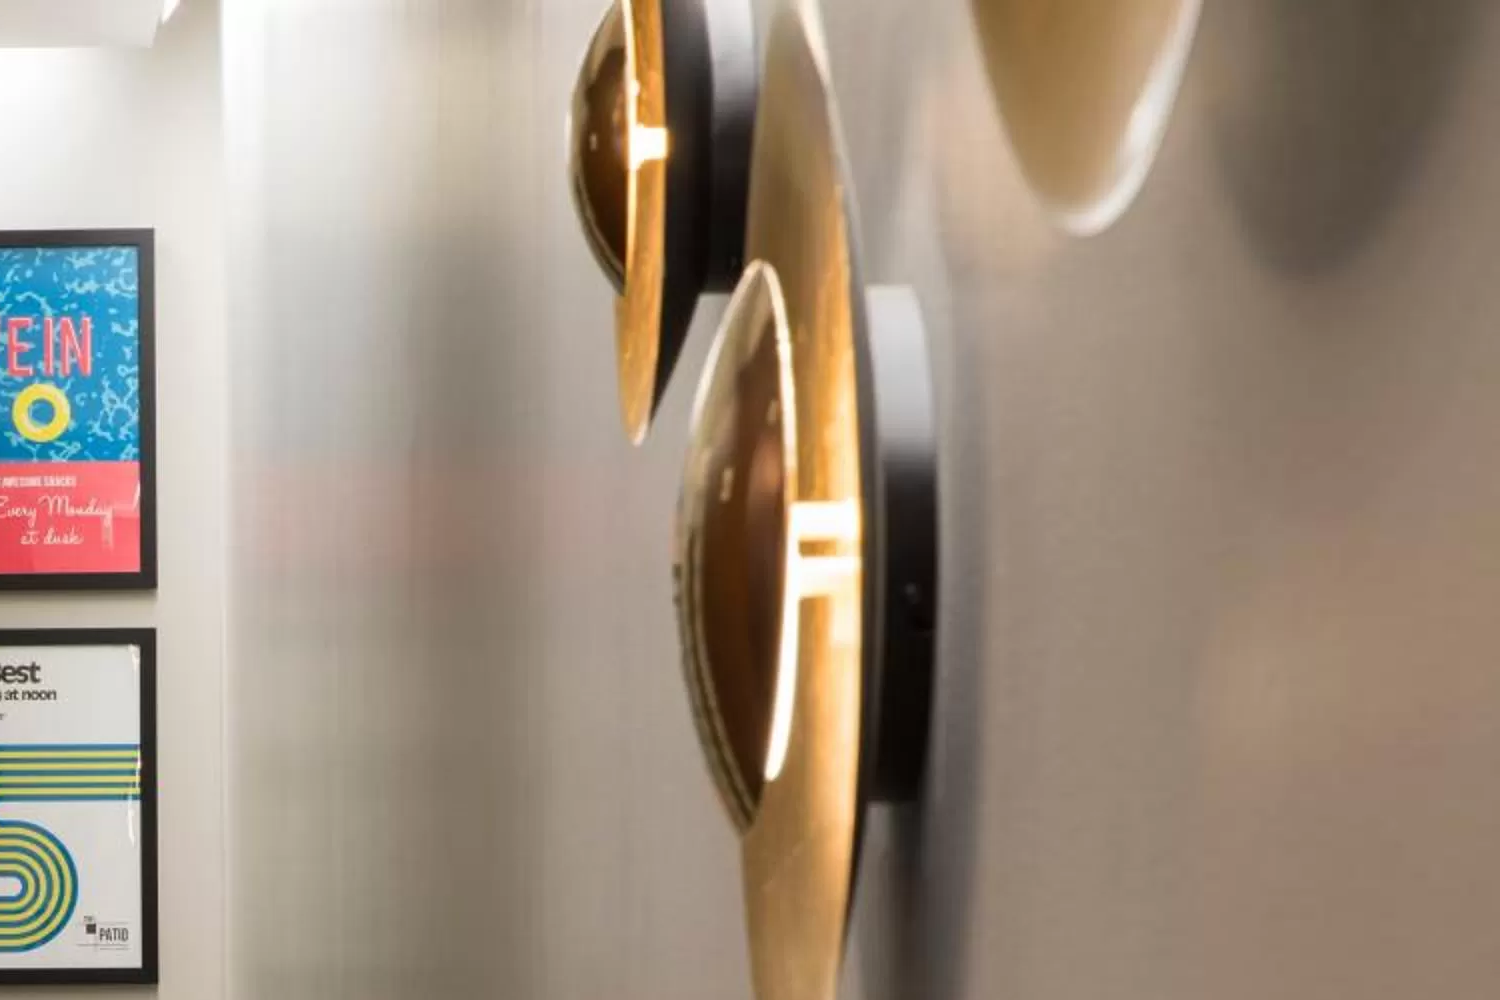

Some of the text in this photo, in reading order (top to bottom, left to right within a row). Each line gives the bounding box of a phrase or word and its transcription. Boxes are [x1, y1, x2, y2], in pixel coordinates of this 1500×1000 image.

[38, 495, 113, 527] Monday
[20, 527, 84, 545] at dusk
[4, 689, 19, 701] at
[22, 690, 57, 701] noon
[100, 928, 129, 942] PATIO
